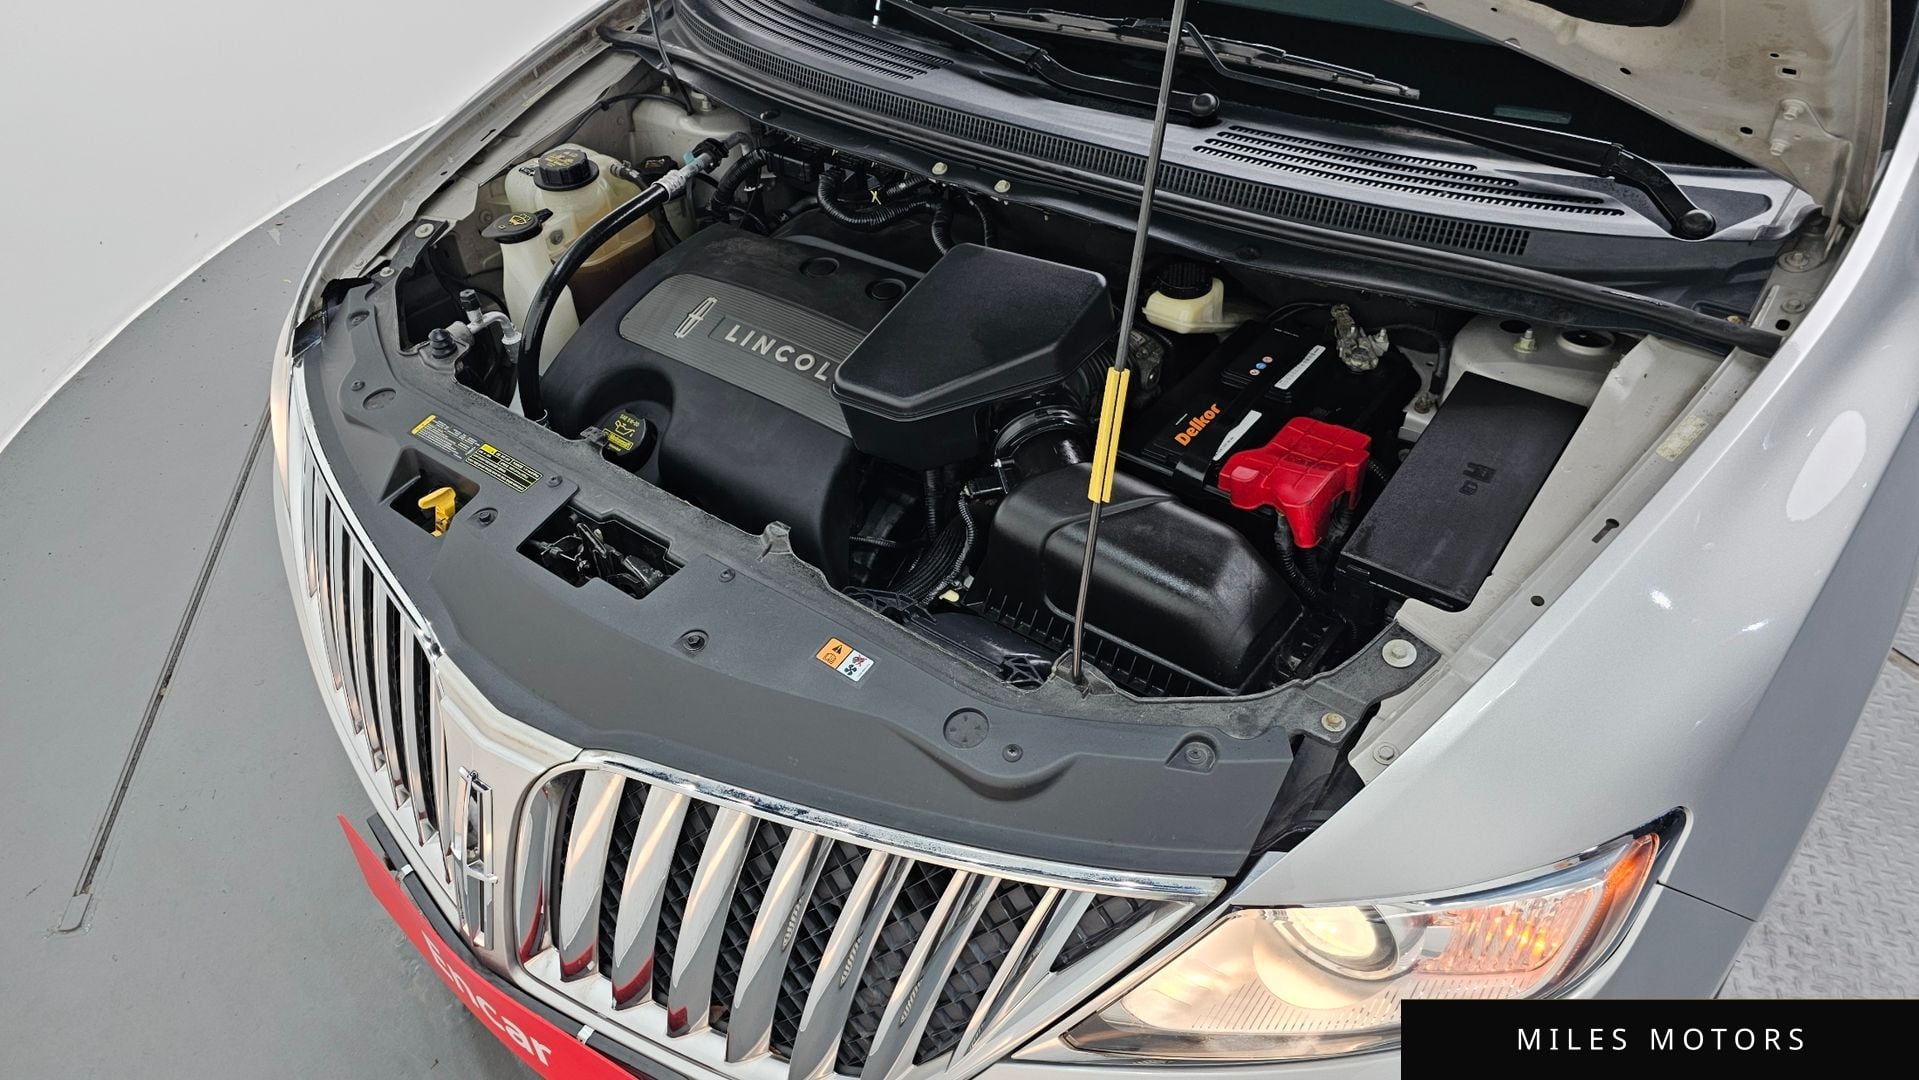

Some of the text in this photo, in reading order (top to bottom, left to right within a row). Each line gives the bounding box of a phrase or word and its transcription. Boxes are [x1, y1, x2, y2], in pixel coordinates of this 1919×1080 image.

[725, 324, 831, 381] LINCOL
[1174, 403, 1221, 447] Delkor
[422, 930, 552, 1067] Encar
